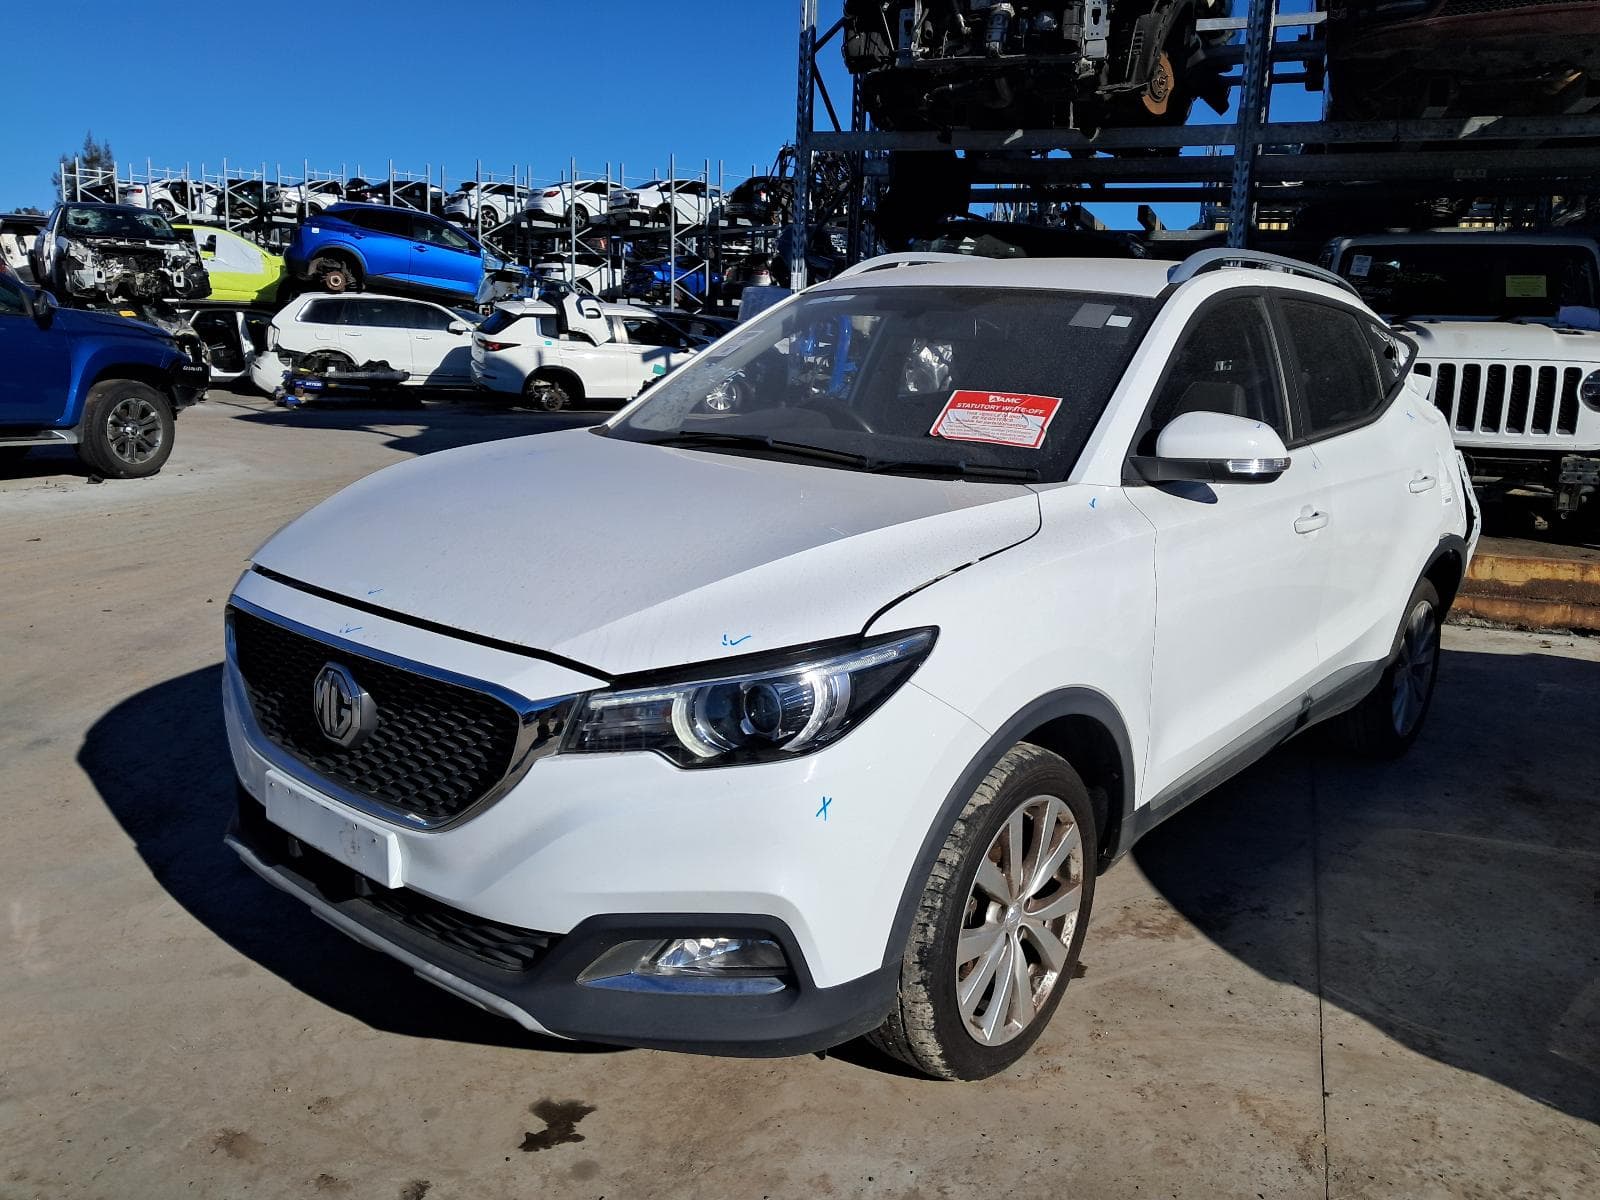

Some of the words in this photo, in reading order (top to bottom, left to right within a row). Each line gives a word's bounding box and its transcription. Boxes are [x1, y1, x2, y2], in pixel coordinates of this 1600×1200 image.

[956, 402, 1002, 411] STATUTORY
[1002, 405, 1046, 416] WRITE-OFF
[316, 670, 352, 738] MG
